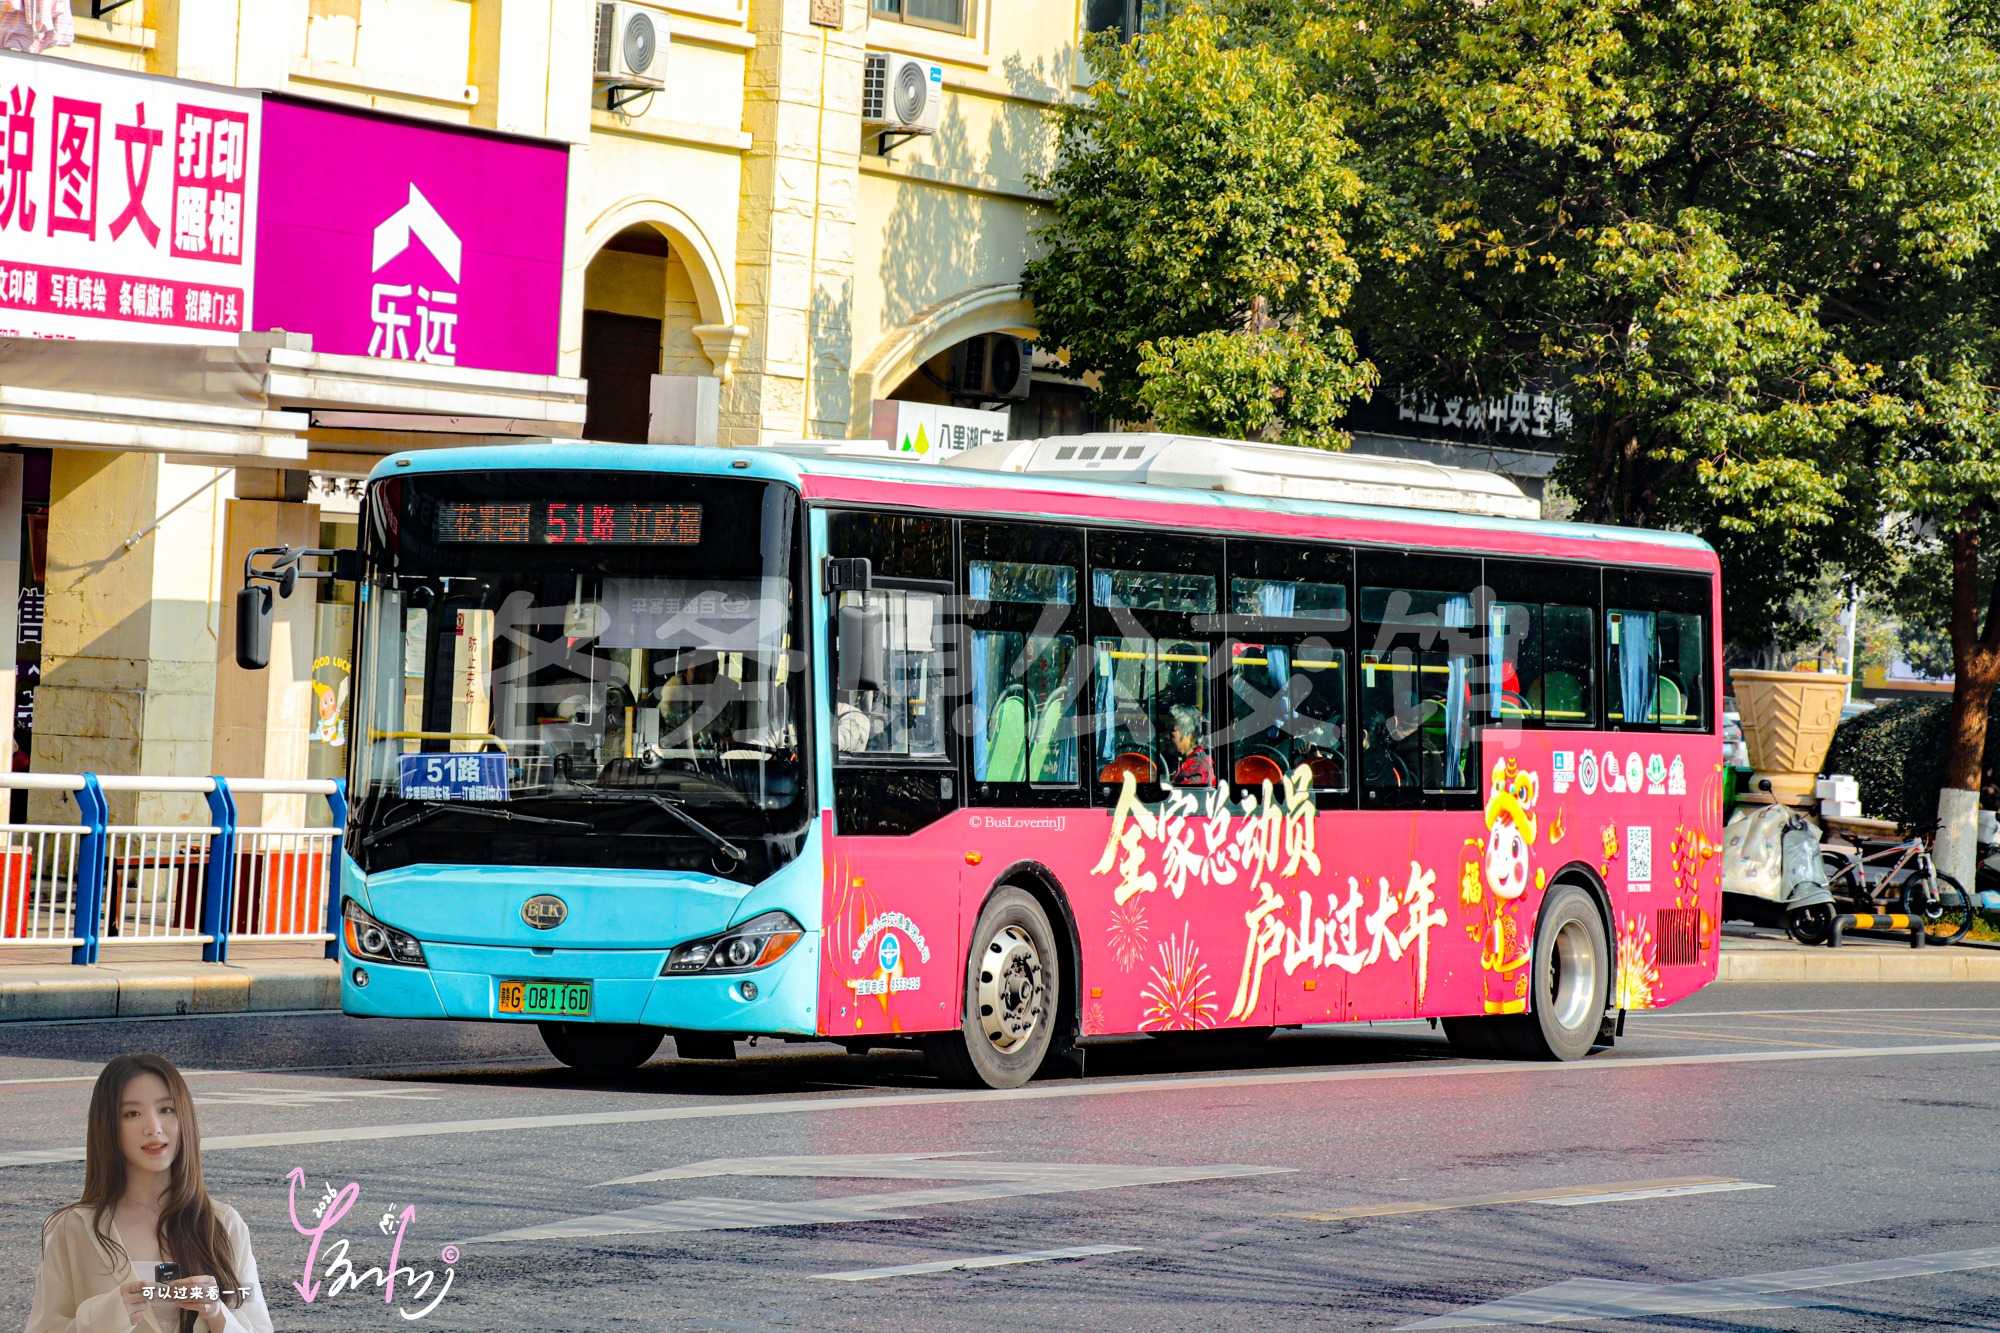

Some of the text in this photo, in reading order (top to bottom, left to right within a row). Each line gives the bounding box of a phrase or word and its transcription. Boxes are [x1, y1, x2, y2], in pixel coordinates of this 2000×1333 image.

[178, 113, 244, 183] 打印
[174, 186, 242, 257] 照相
[51, 273, 107, 313] 写真喷绘
[119, 281, 174, 319] 条幅旗帜
[185, 288, 238, 326] 招牌门头
[367, 282, 459, 367] 乐远
[547, 503, 615, 542] 51路
[332, 656, 351, 673] LUCK
[426, 757, 480, 783] 51路
[1090, 763, 1321, 906] 全家总动员
[1462, 861, 1483, 905] 福
[1224, 860, 1449, 1023] 庐山过大年
